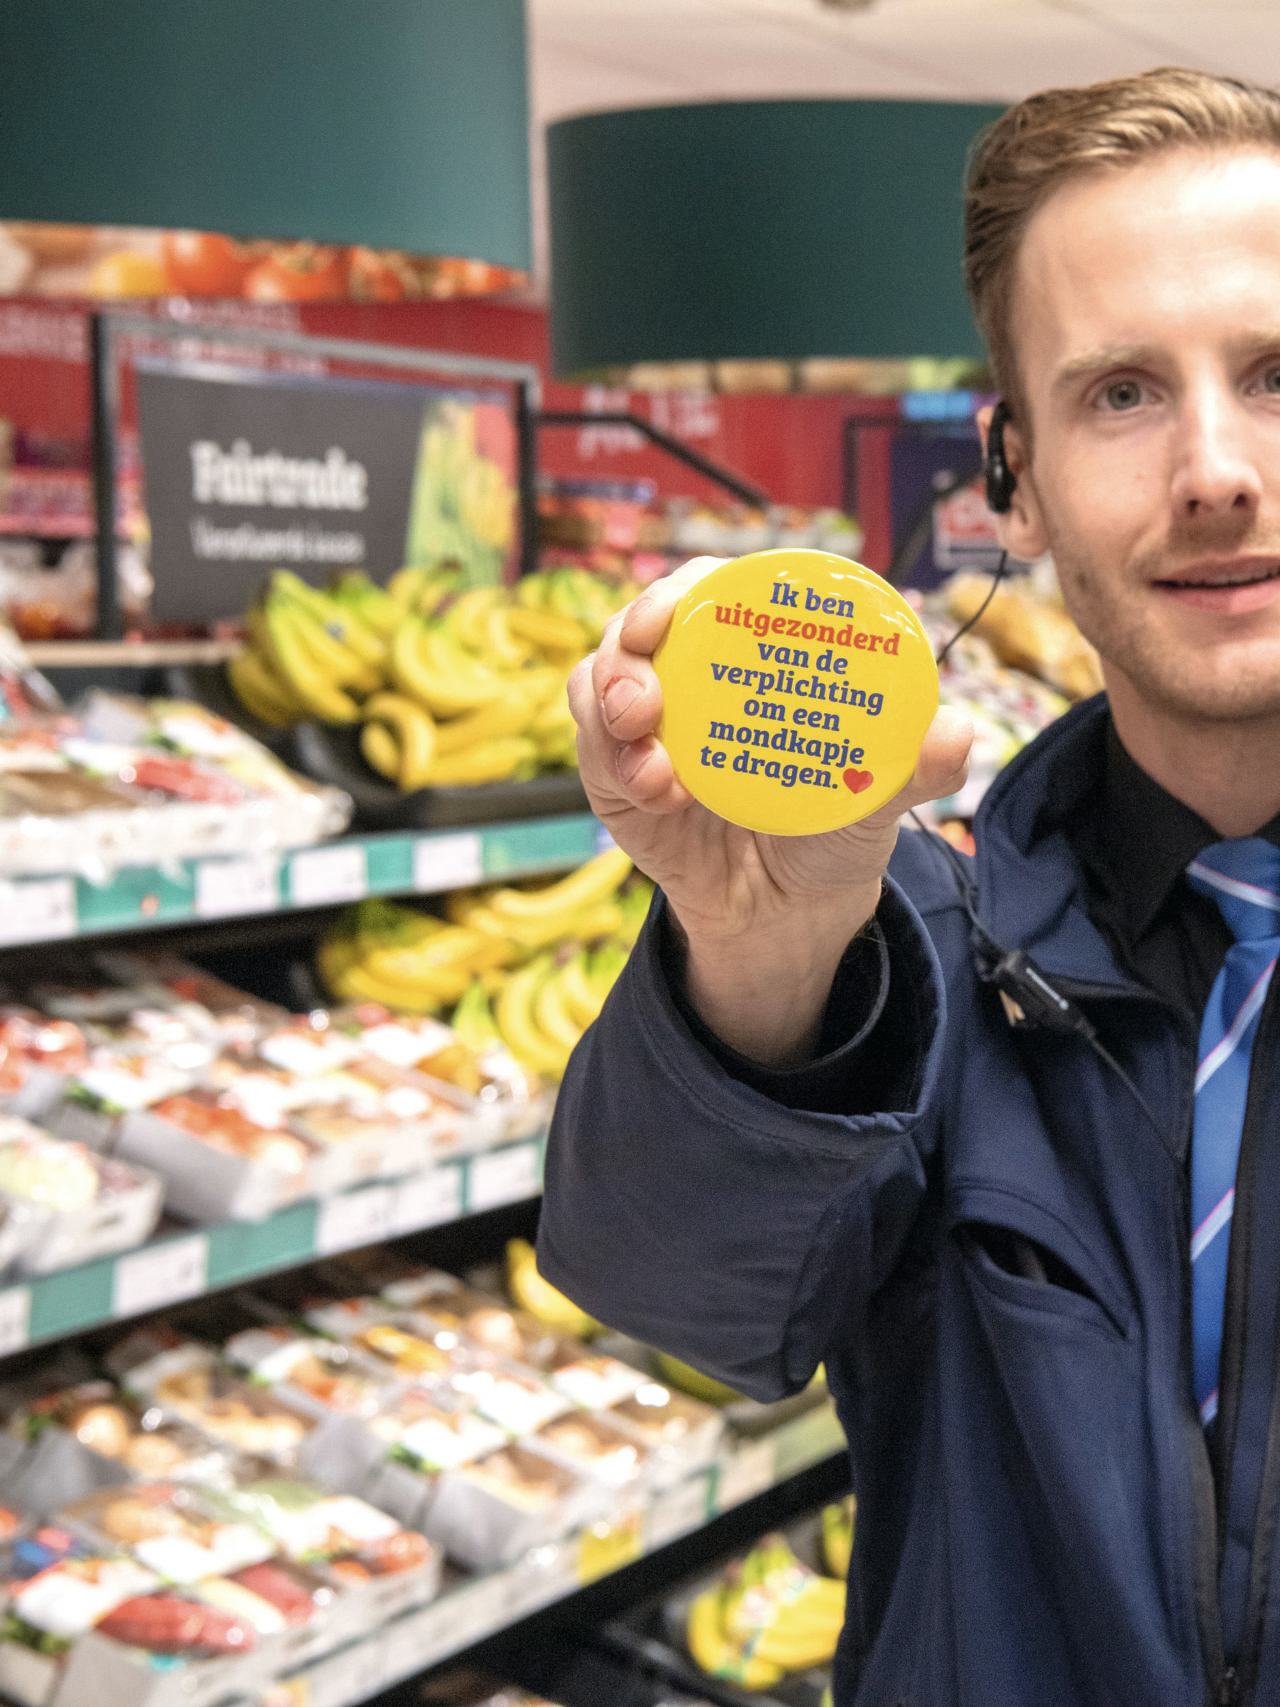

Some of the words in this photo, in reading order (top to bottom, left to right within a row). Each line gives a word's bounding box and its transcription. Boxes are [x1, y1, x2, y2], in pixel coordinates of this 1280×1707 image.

[191, 439, 369, 510] Fairtrade
[769, 582, 800, 609] Ik
[805, 588, 855, 618] ben
[715, 603, 901, 655] uitgezonderd
[757, 642, 809, 668] van
[815, 650, 849, 675] de
[710, 662, 884, 715] verplichting
[743, 699, 786, 722] om
[792, 708, 841, 732] een
[708, 721, 865, 768] mondkapje
[700, 746, 727, 769] te
[732, 750, 839, 789] dragen.
